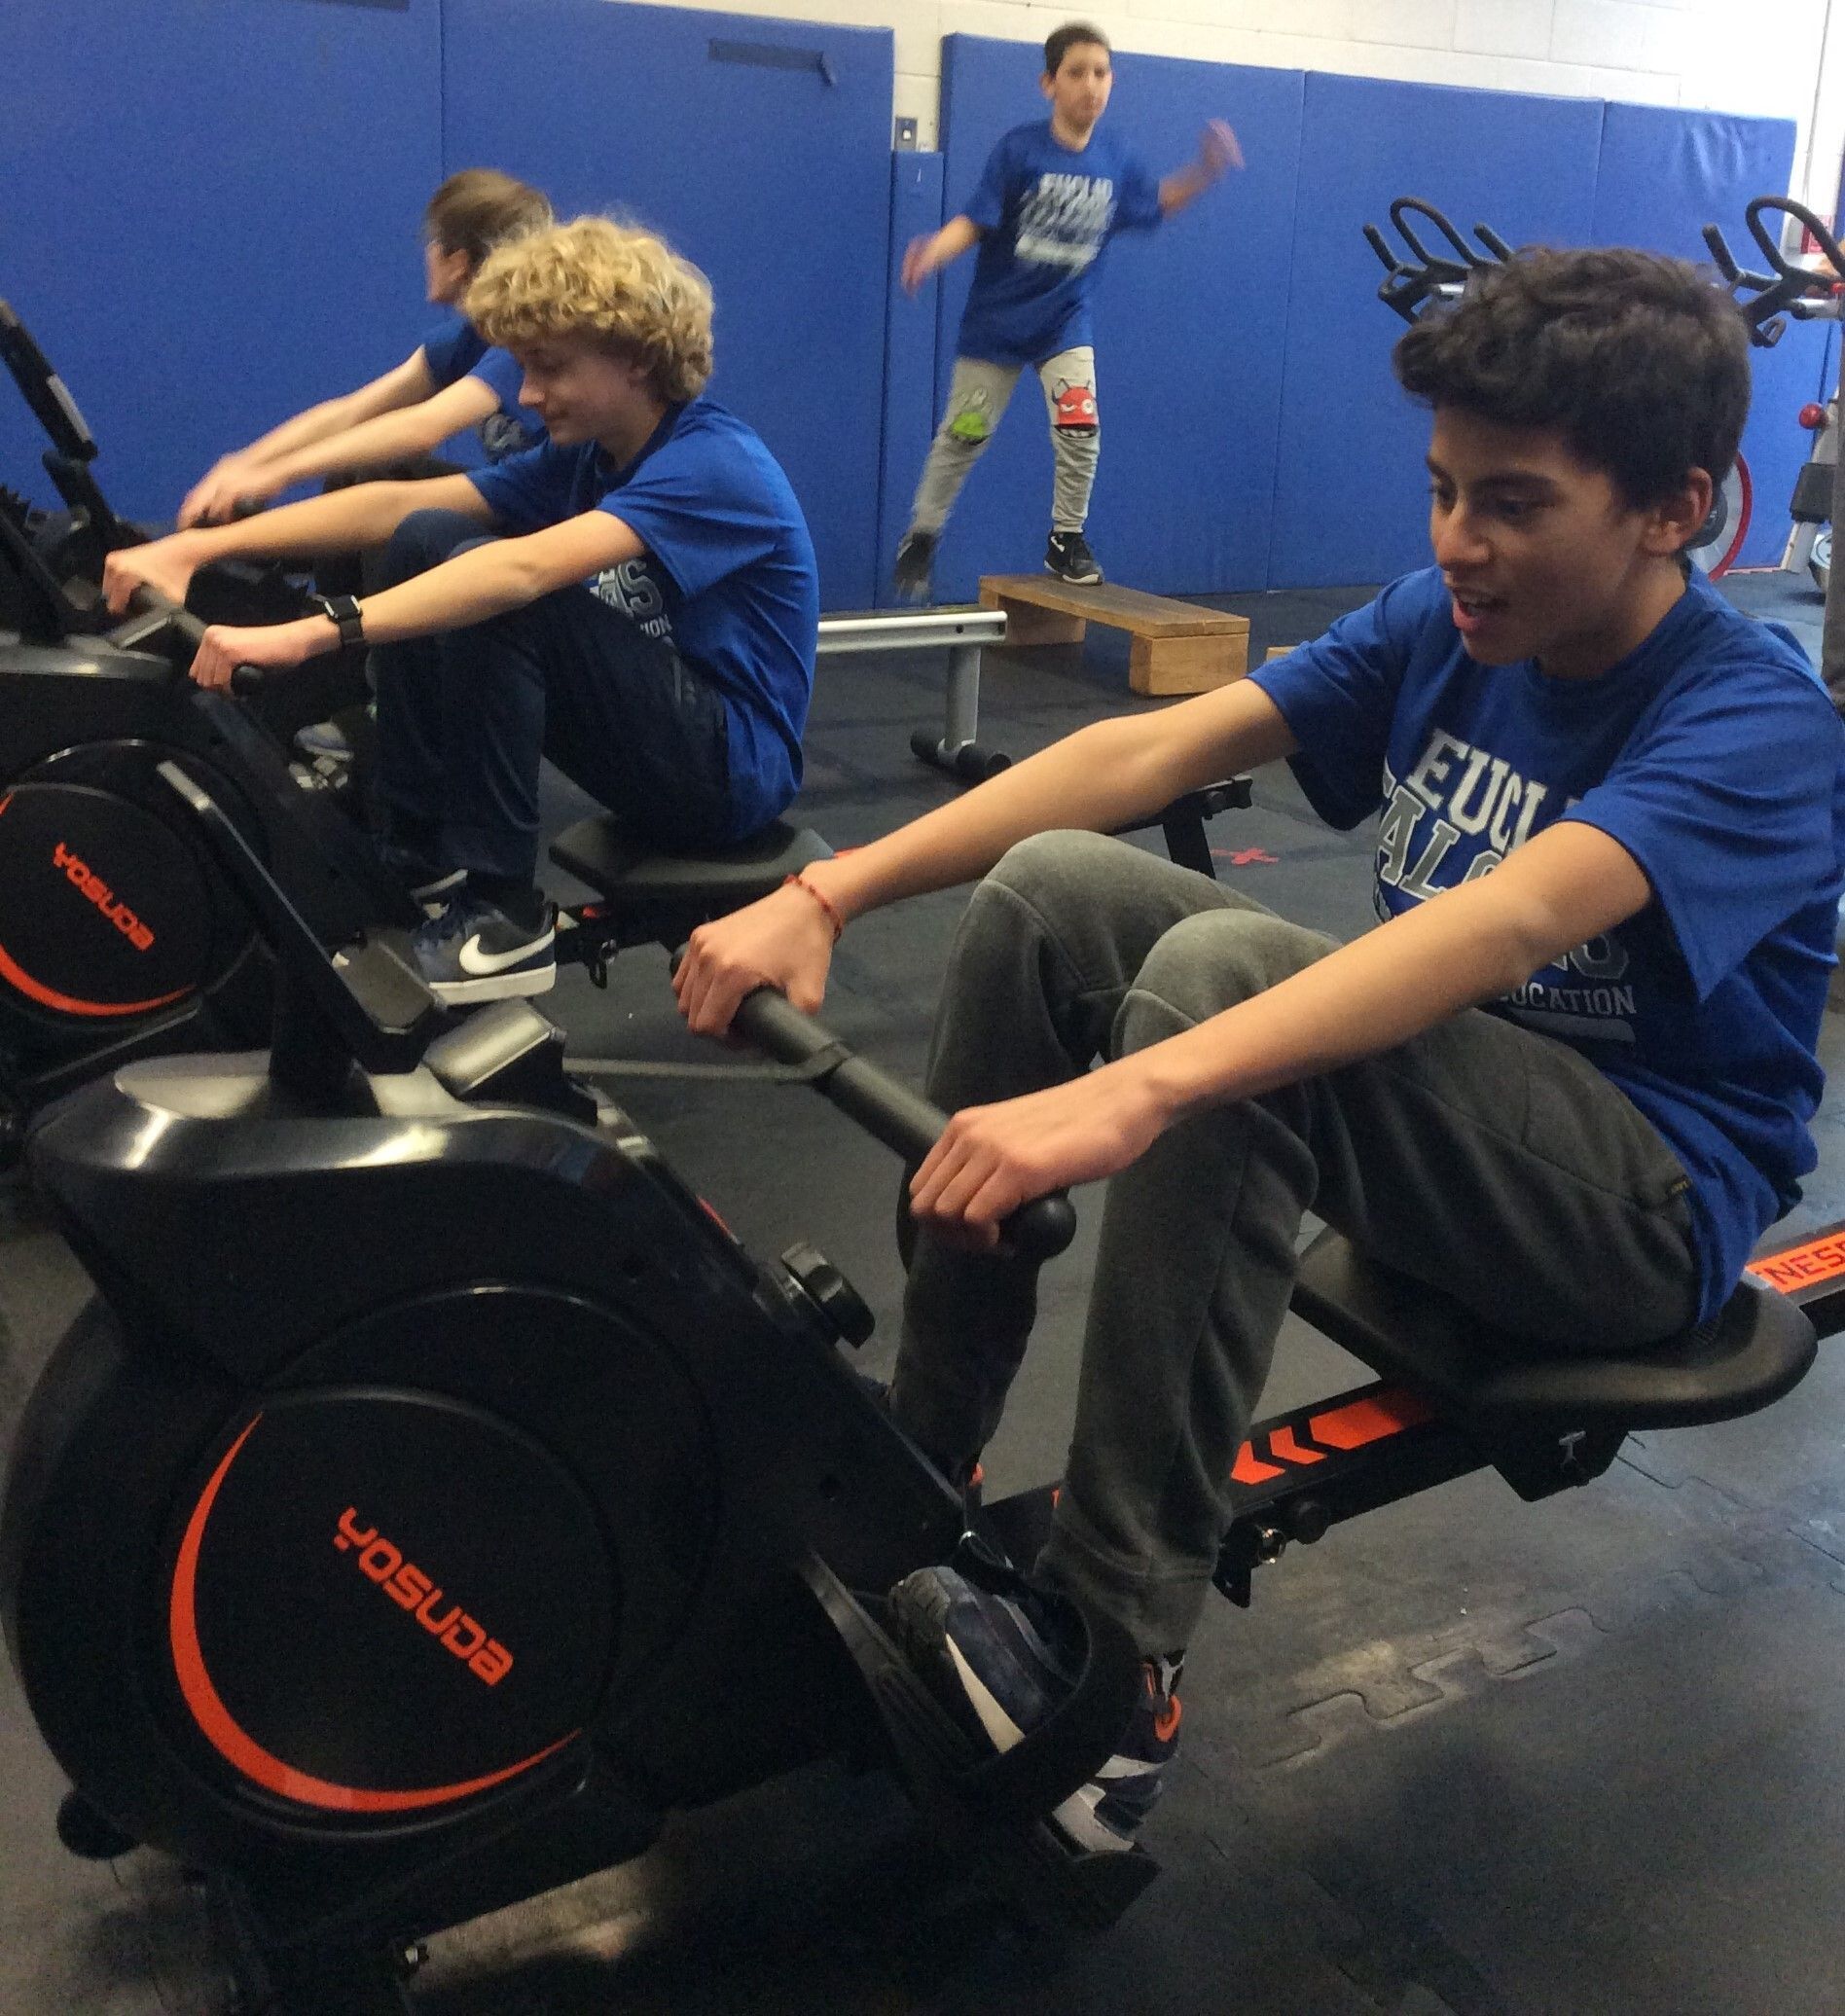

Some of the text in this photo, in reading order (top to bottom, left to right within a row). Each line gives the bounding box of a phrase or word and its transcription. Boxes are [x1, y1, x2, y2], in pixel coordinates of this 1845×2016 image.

[1406, 730, 1580, 852] EUCL
[53, 842, 155, 950] YOSUDA
[1501, 981, 1637, 1015] UCATION
[1757, 1242, 1845, 1285] NES
[334, 1506, 513, 1685] YOSUDA
